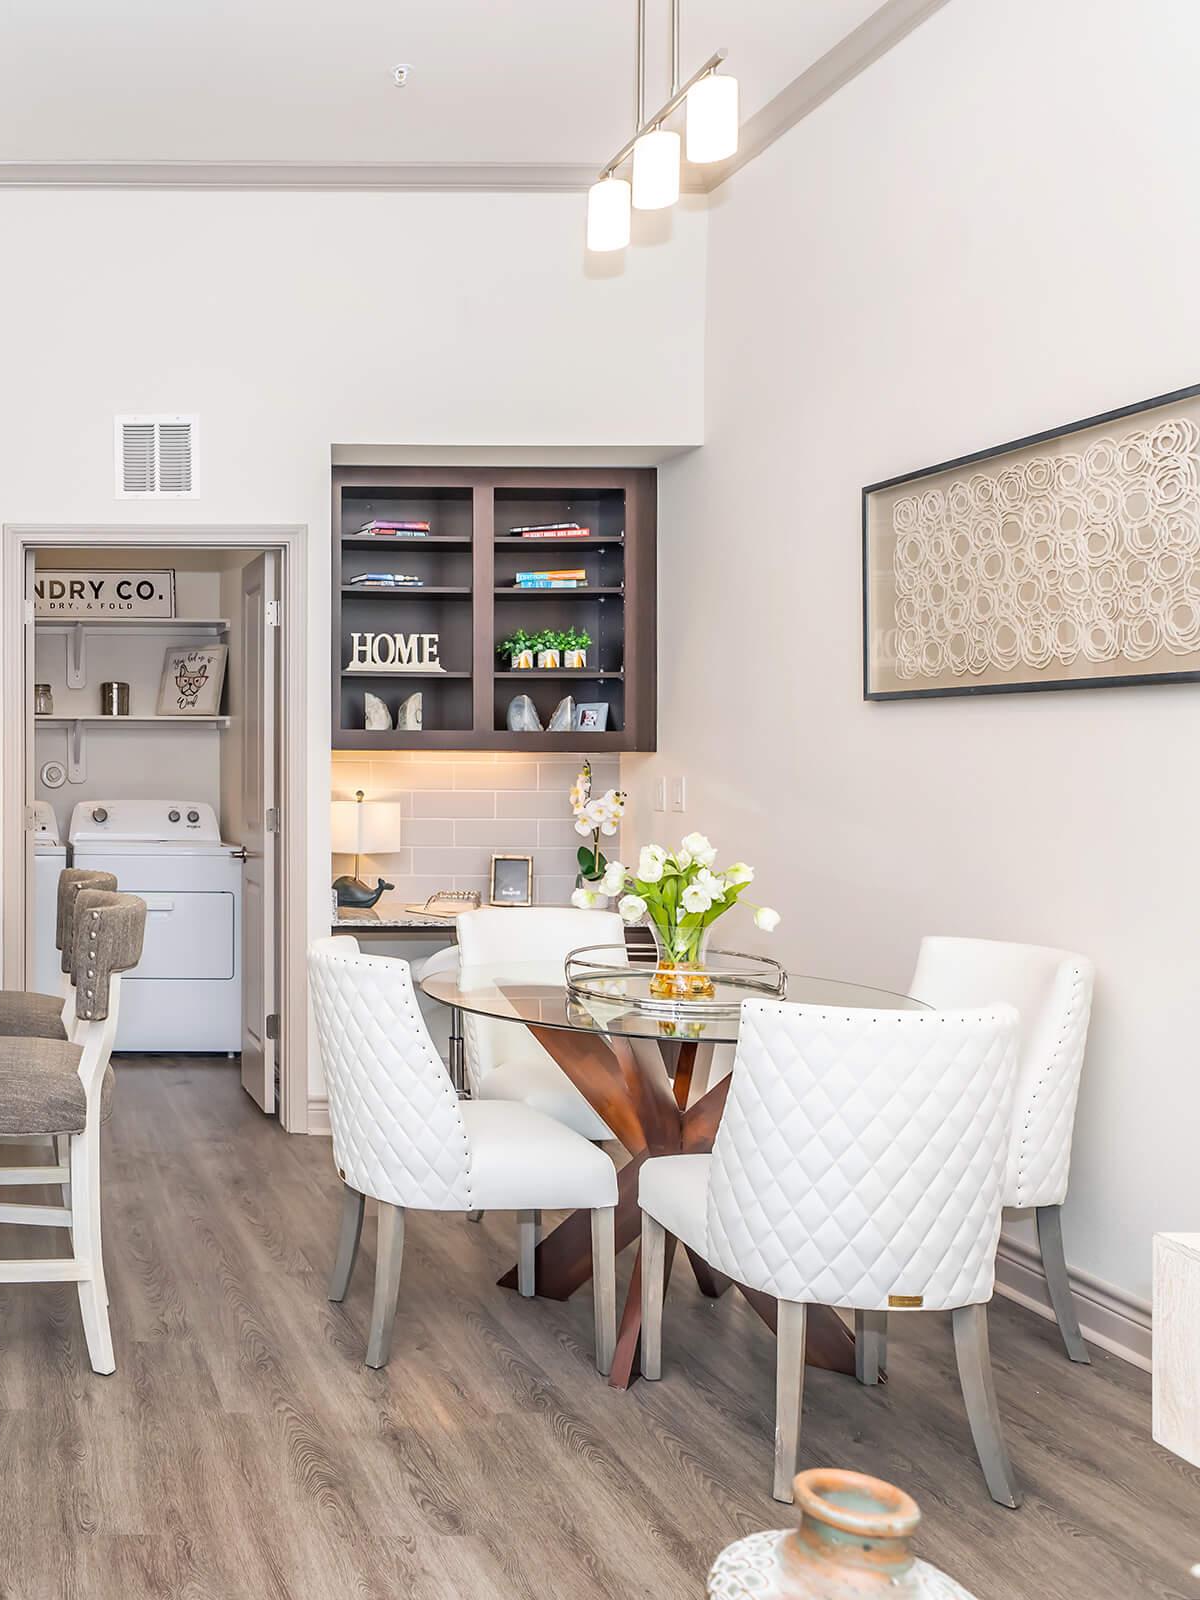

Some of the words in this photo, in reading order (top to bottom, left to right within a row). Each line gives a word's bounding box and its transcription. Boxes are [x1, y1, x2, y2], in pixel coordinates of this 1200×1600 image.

[116, 580, 164, 601] CO.
[86, 602, 93, 610] &
[100, 602, 133, 610] FOLD
[350, 632, 440, 664] HOME
